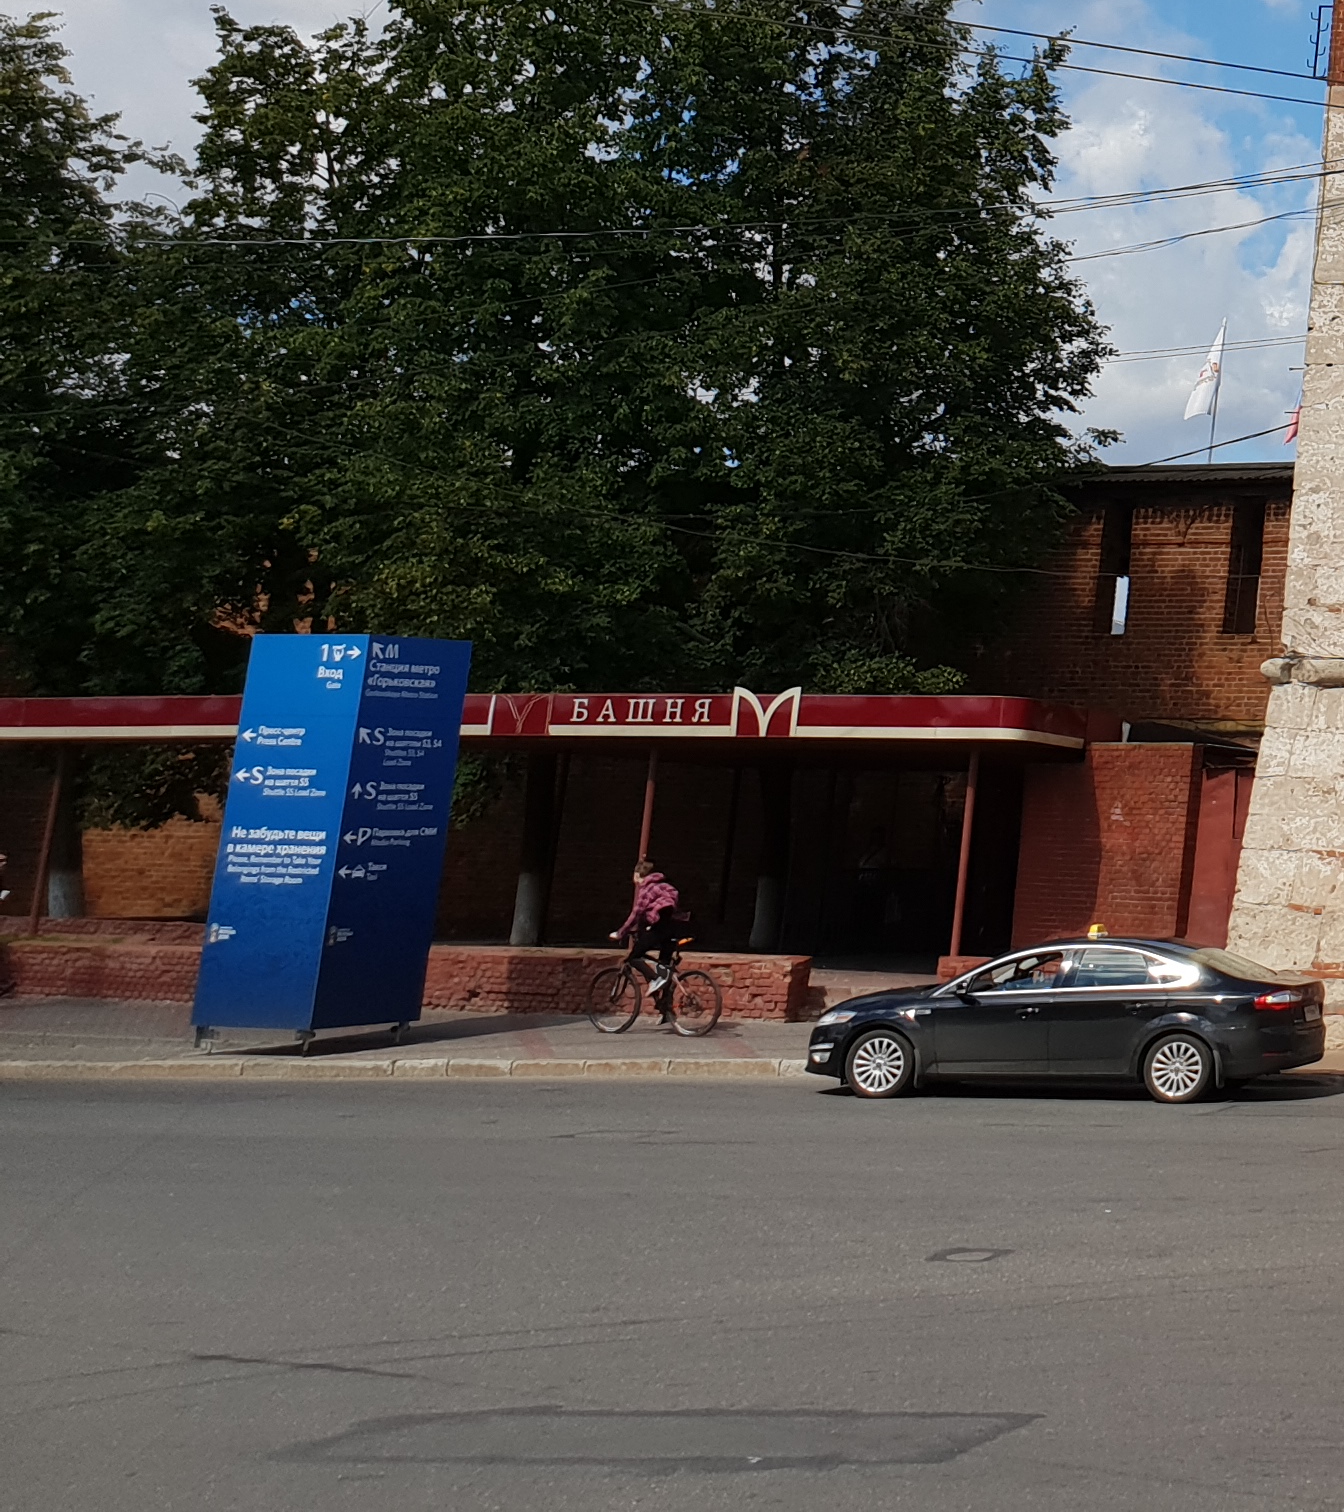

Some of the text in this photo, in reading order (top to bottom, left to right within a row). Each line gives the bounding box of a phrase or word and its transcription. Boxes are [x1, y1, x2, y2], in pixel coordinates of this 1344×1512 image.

[321, 643, 330, 662] 1
[317, 665, 344, 680] Вход
[369, 659, 441, 677] Станция метро
[569, 698, 713, 723] БАШНЯ
[258, 725, 306, 737] Пресс-центр
[257, 735, 277, 745] Press
[250, 766, 264, 785] S
[363, 781, 377, 800] S
[231, 825, 327, 842] Не забудьте вещи
[226, 843, 327, 856] в камере хранения
